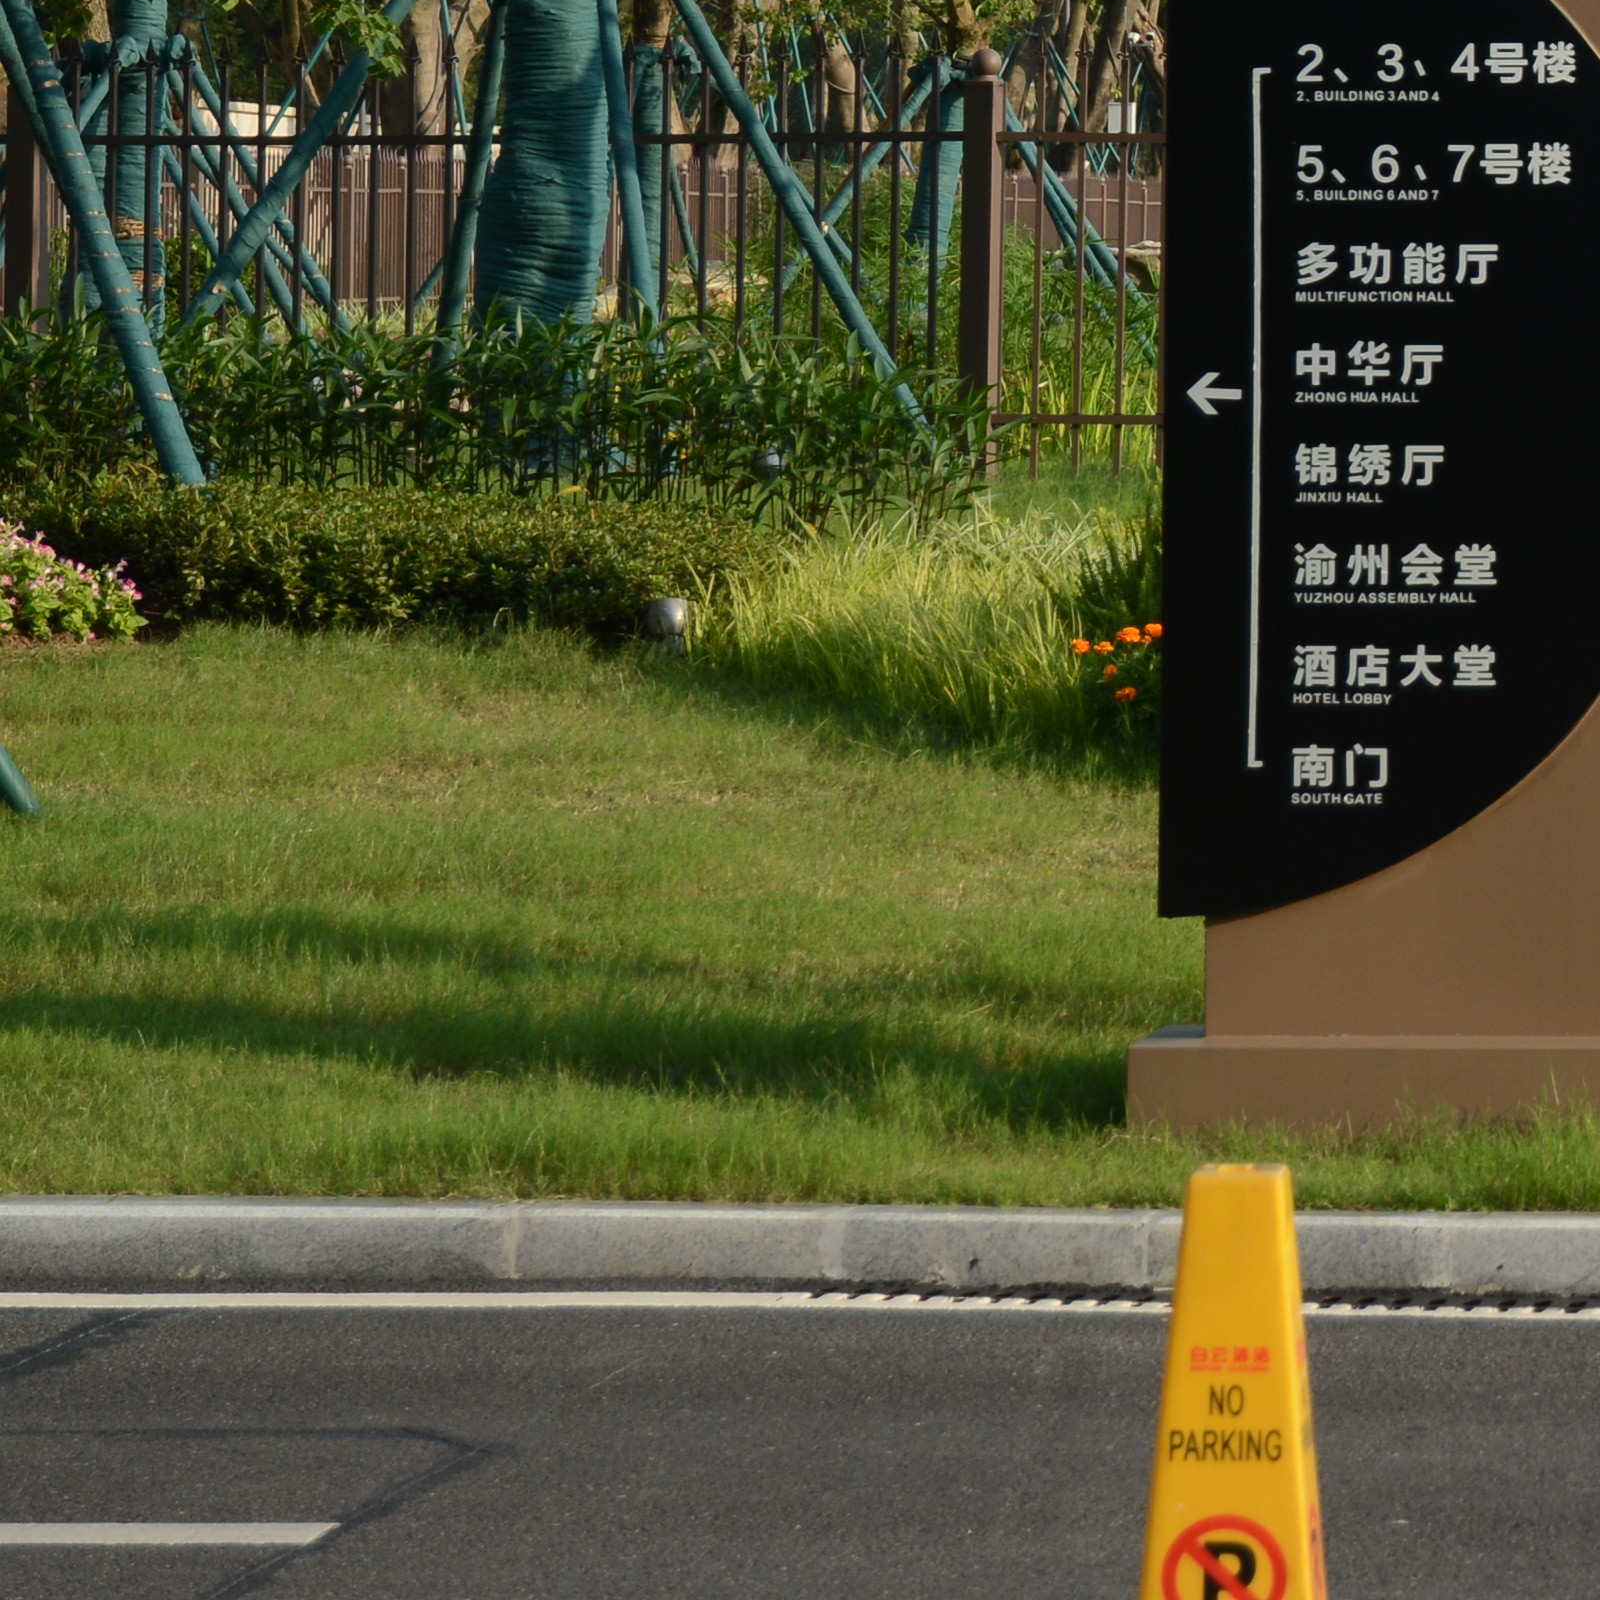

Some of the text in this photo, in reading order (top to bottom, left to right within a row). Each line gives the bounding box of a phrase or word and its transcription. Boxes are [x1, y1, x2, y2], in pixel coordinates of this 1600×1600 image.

[1314, 89, 1385, 102] BUILDING
[1387, 89, 1396, 102] 3
[1397, 89, 1429, 102] AND
[1431, 89, 1440, 102] 4
[1313, 189, 1384, 202] BUILDING
[1386, 189, 1395, 202] 6
[1397, 189, 1429, 202] AND
[1431, 189, 1439, 202] 7
[1296, 241, 1499, 286] 多功能厅
[1295, 290, 1455, 303] MULTIFUNCTION HALL
[1295, 340, 1444, 386] 中华厅
[1294, 391, 1419, 403] ZHONG HUA HALL
[1294, 443, 1445, 486] 锦绣厅
[1295, 491, 1384, 503] JINXIU HALL
[1294, 542, 1498, 586] 渝州会堂
[1294, 592, 1476, 604] YUZHOU ASSEMBLY HALL
[1293, 644, 1497, 687] 酒店大堂
[1292, 692, 1392, 705] HOTEL LOBBY
[1291, 743, 1388, 788] 南门
[1291, 792, 1383, 805] SOUTH GATE
[1209, 1384, 1244, 1416] NO
[1168, 1429, 1282, 1462] PARKING
